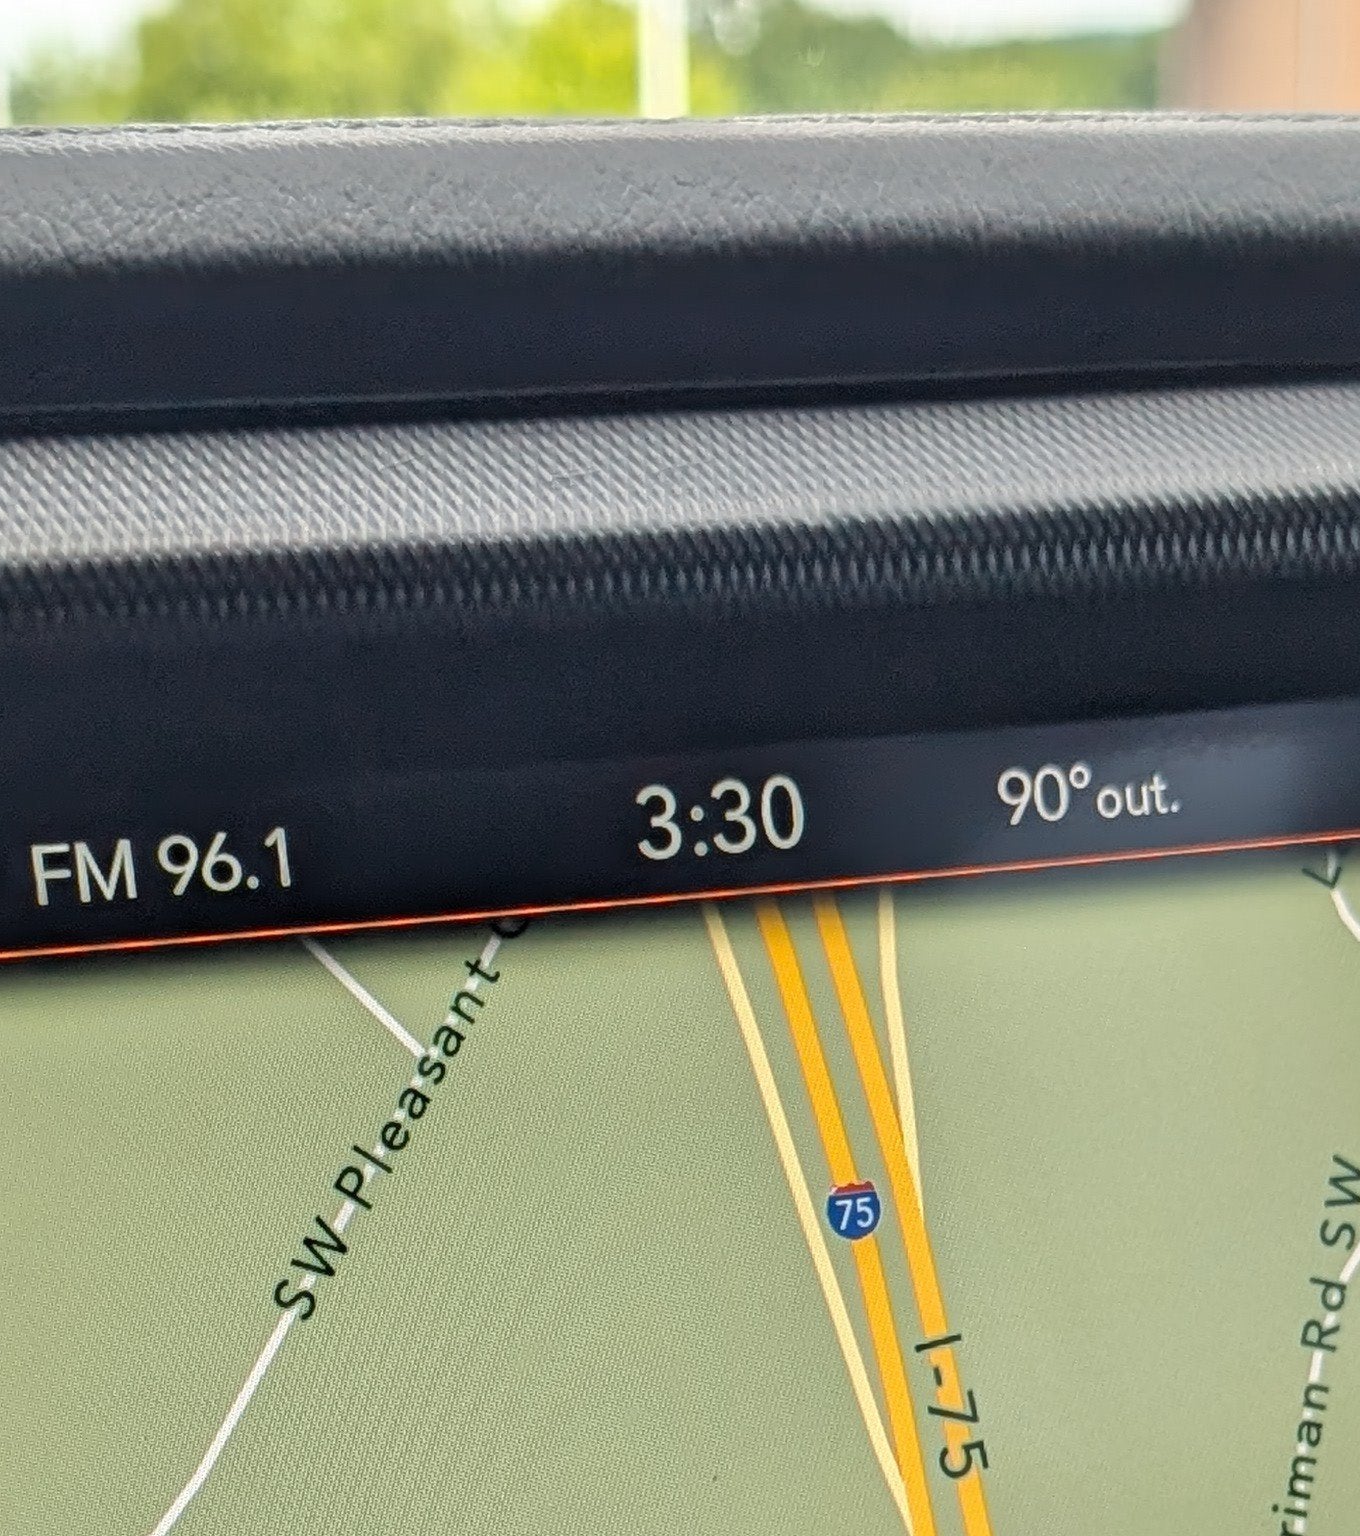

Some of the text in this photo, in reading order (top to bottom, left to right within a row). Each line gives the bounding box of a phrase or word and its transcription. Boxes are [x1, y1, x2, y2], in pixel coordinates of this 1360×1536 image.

[637, 775, 805, 860] 3:30
[31, 827, 293, 906] FM 96.1
[274, 958, 500, 1320] SW Pleasant
[835, 1197, 874, 1230] 75
[1301, 1277, 1347, 1353] Rd
[915, 1334, 988, 1478] I-75
